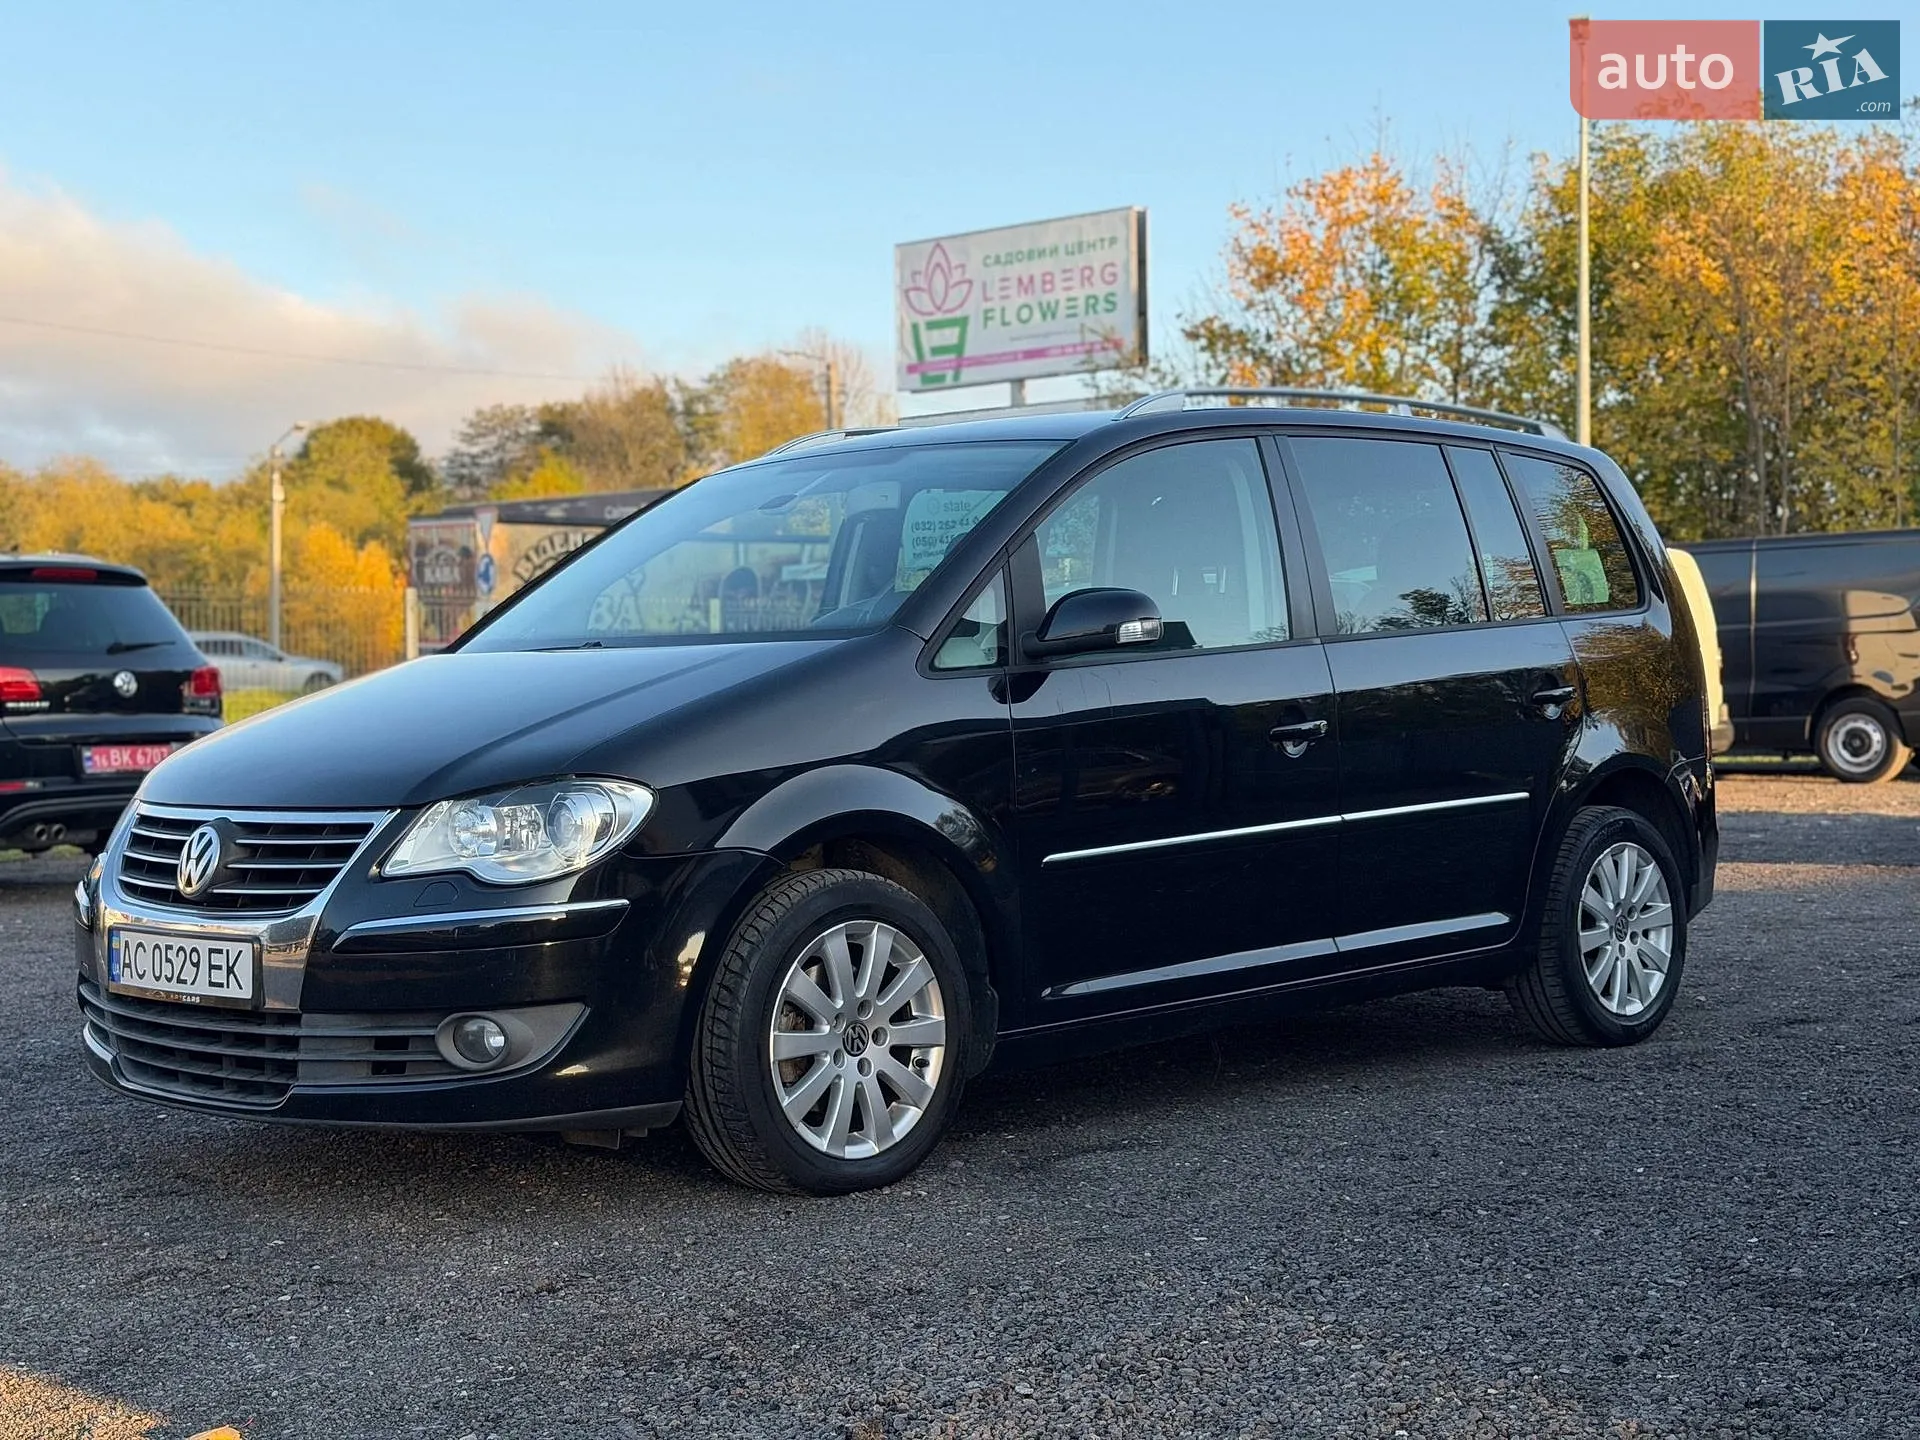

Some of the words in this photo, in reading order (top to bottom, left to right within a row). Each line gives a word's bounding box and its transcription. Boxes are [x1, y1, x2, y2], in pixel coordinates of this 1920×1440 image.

[1064, 235, 1119, 257] ЦЕНТР
[982, 262, 1119, 303] LEMBERG
[982, 292, 1118, 330] FLOWERS
[109, 748, 133, 767] BK
[121, 939, 147, 981] AC
[152, 943, 201, 987] 0529
[207, 947, 243, 990] EK
